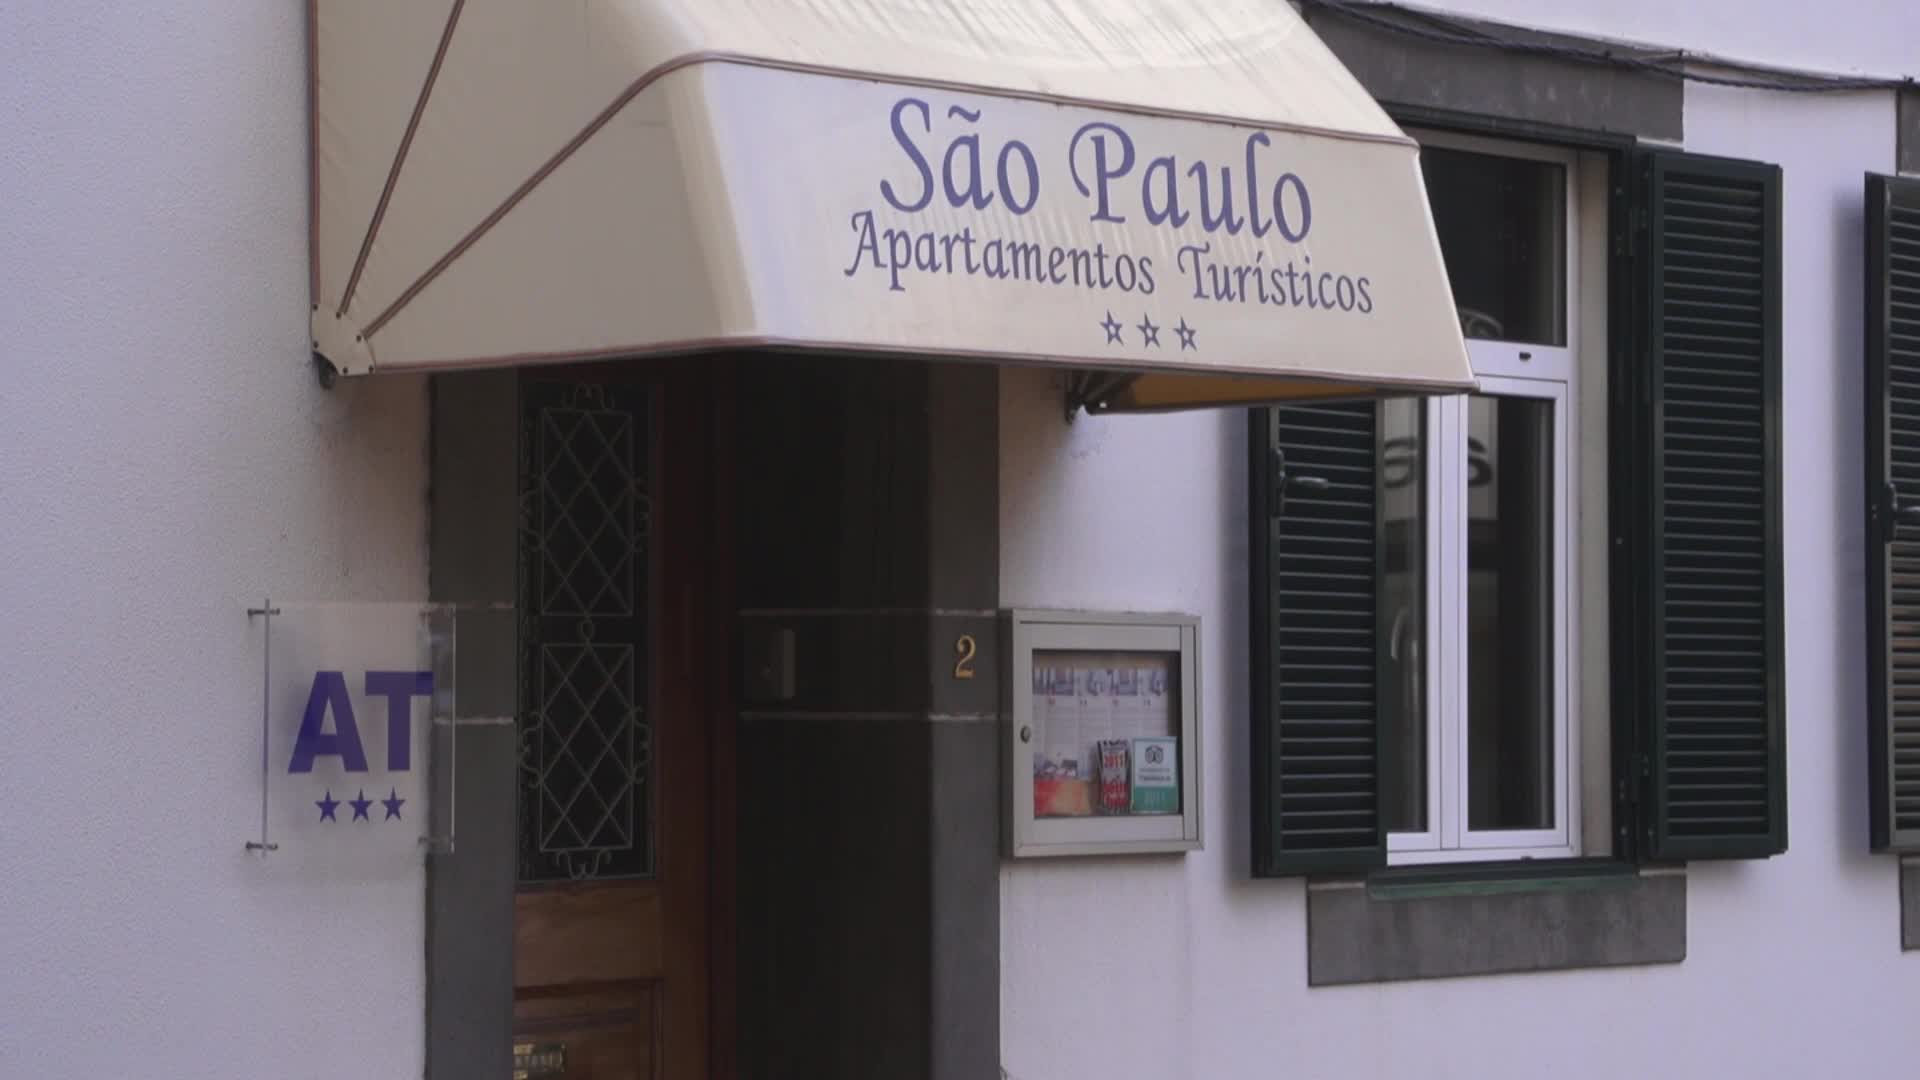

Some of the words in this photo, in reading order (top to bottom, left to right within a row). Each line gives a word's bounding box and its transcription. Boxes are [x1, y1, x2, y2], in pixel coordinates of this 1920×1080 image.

[880, 97, 1039, 216] São
[1069, 122, 1312, 244] Paulo
[844, 210, 1155, 295] Apartamentos
[1177, 242, 1373, 313] Turísticos
[954, 634, 977, 680] 2
[288, 671, 434, 774] AT
